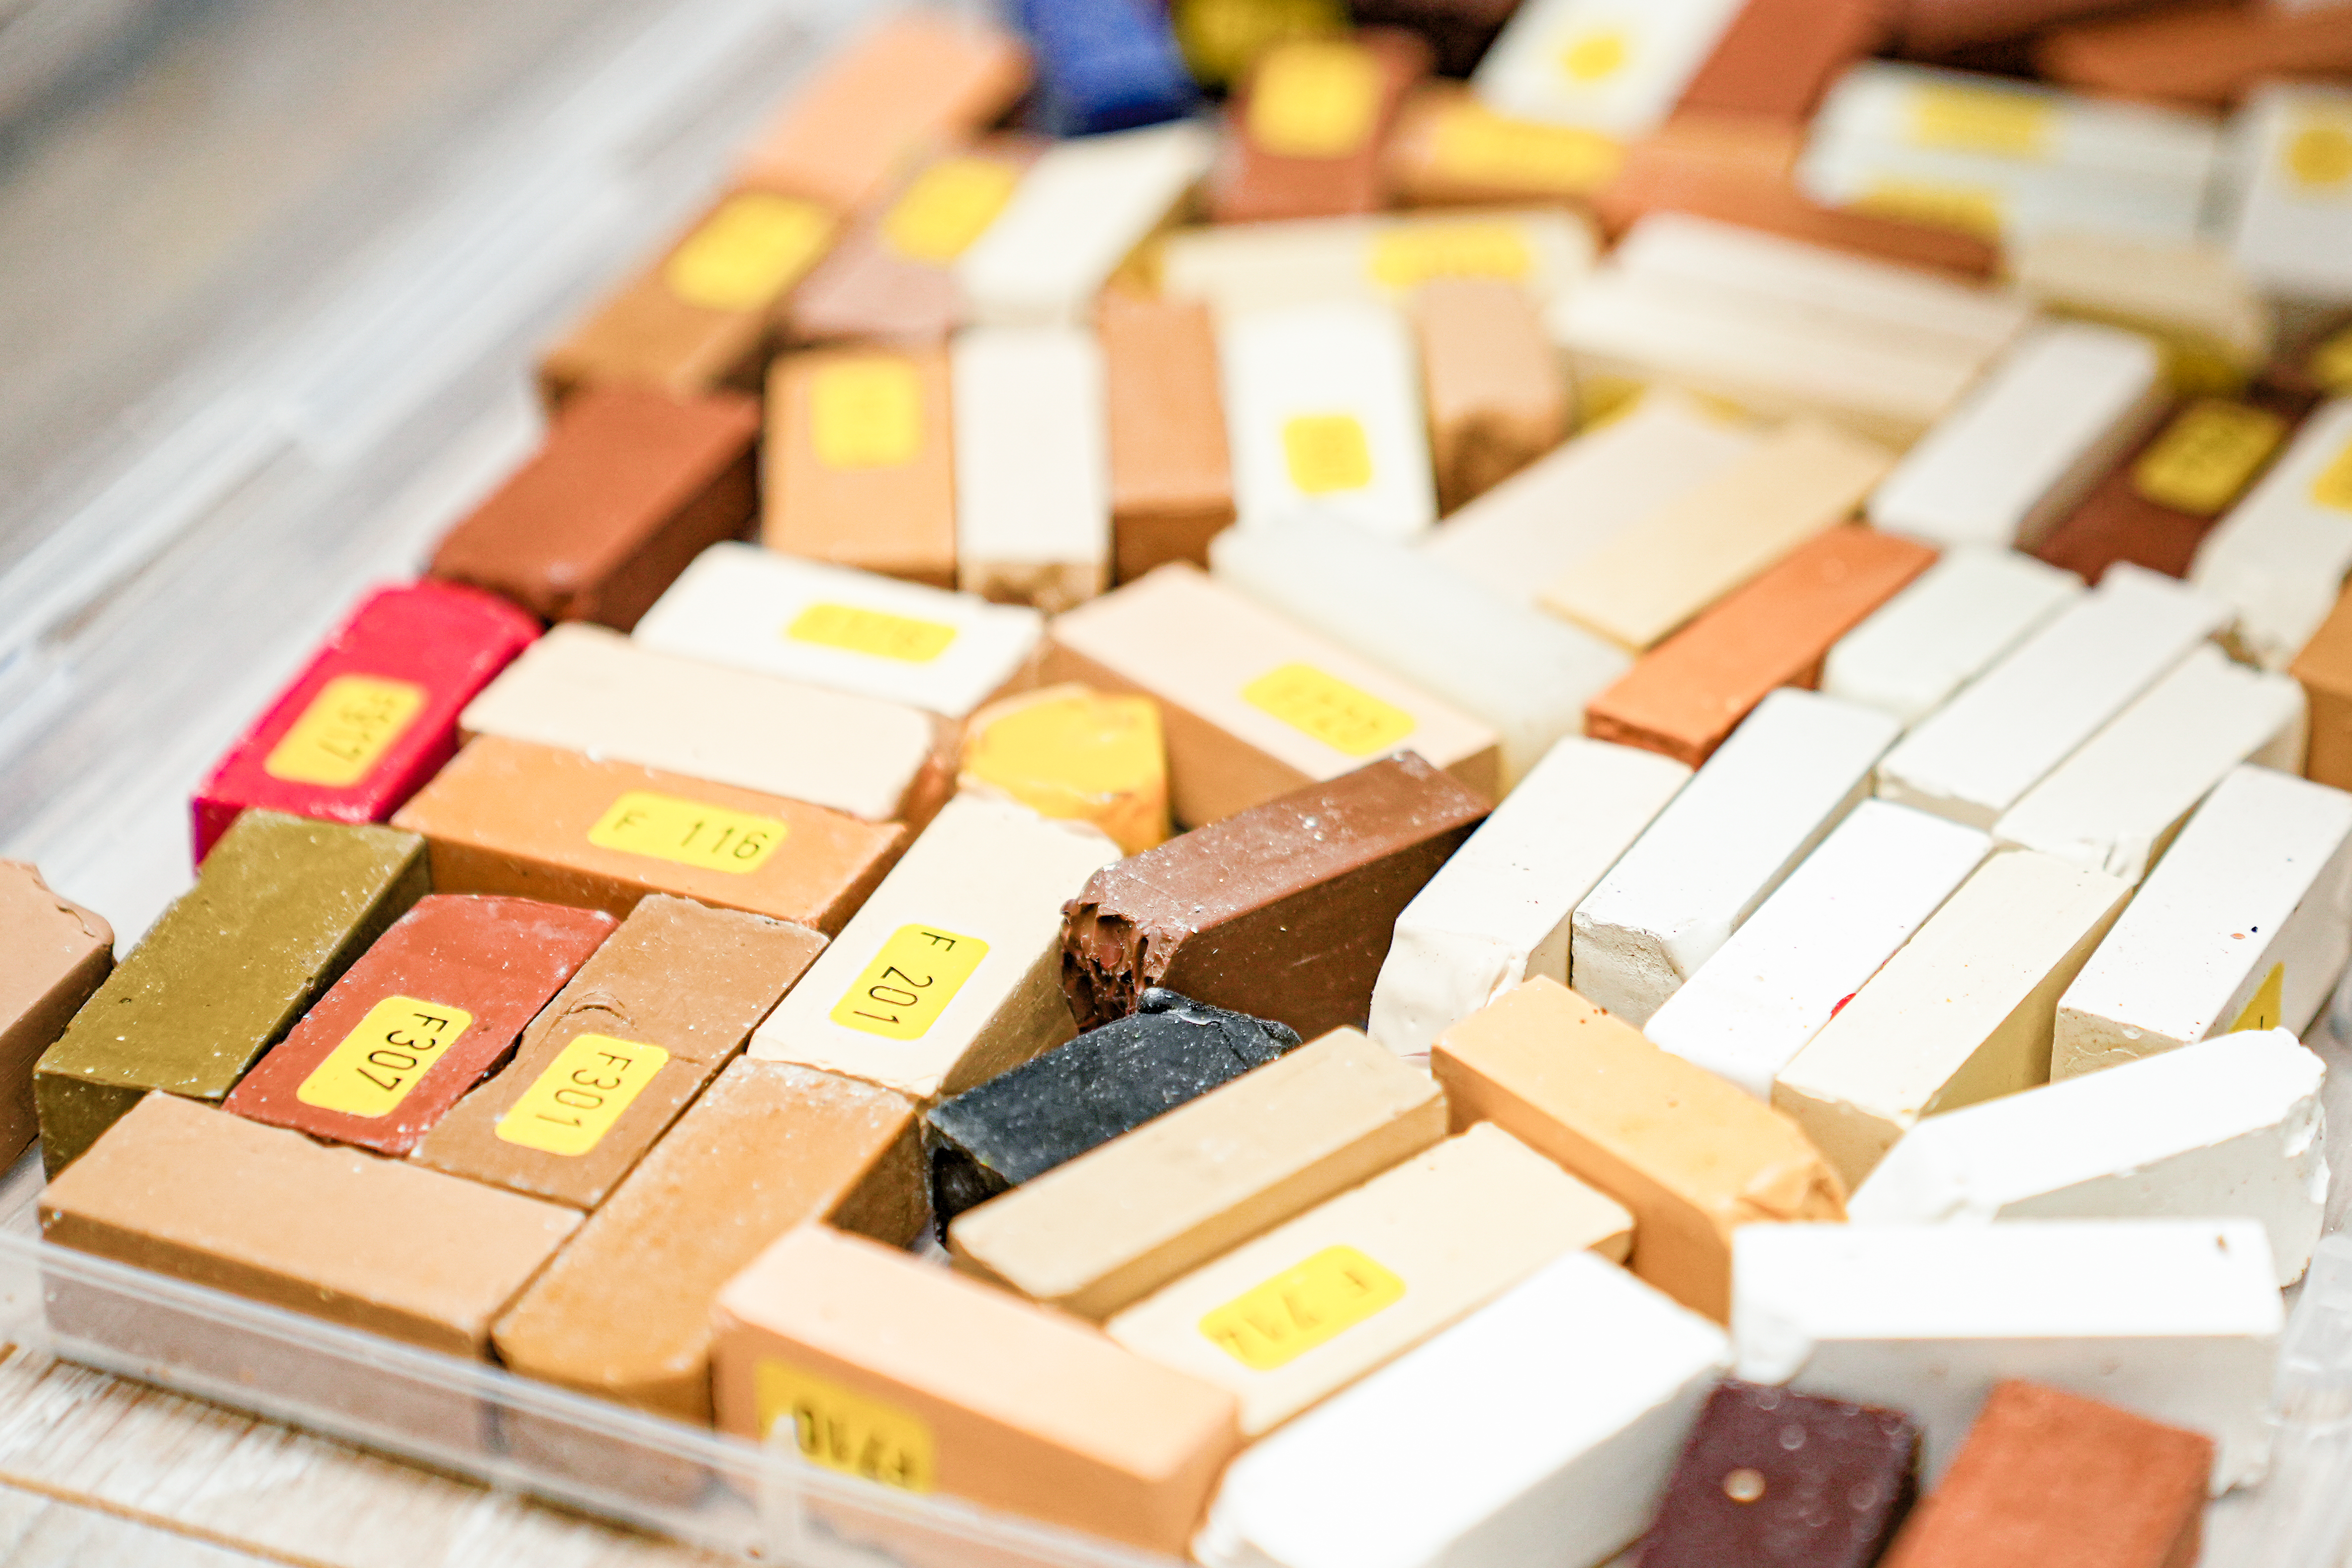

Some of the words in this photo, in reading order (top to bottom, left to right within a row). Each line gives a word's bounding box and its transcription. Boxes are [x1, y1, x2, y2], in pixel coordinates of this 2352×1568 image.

[614, 809, 649, 830] F
[681, 819, 769, 860] 116
[920, 931, 957, 952] F
[852, 966, 933, 1025] 201
[356, 1012, 449, 1092] F307
[536, 1051, 633, 1128] F301
